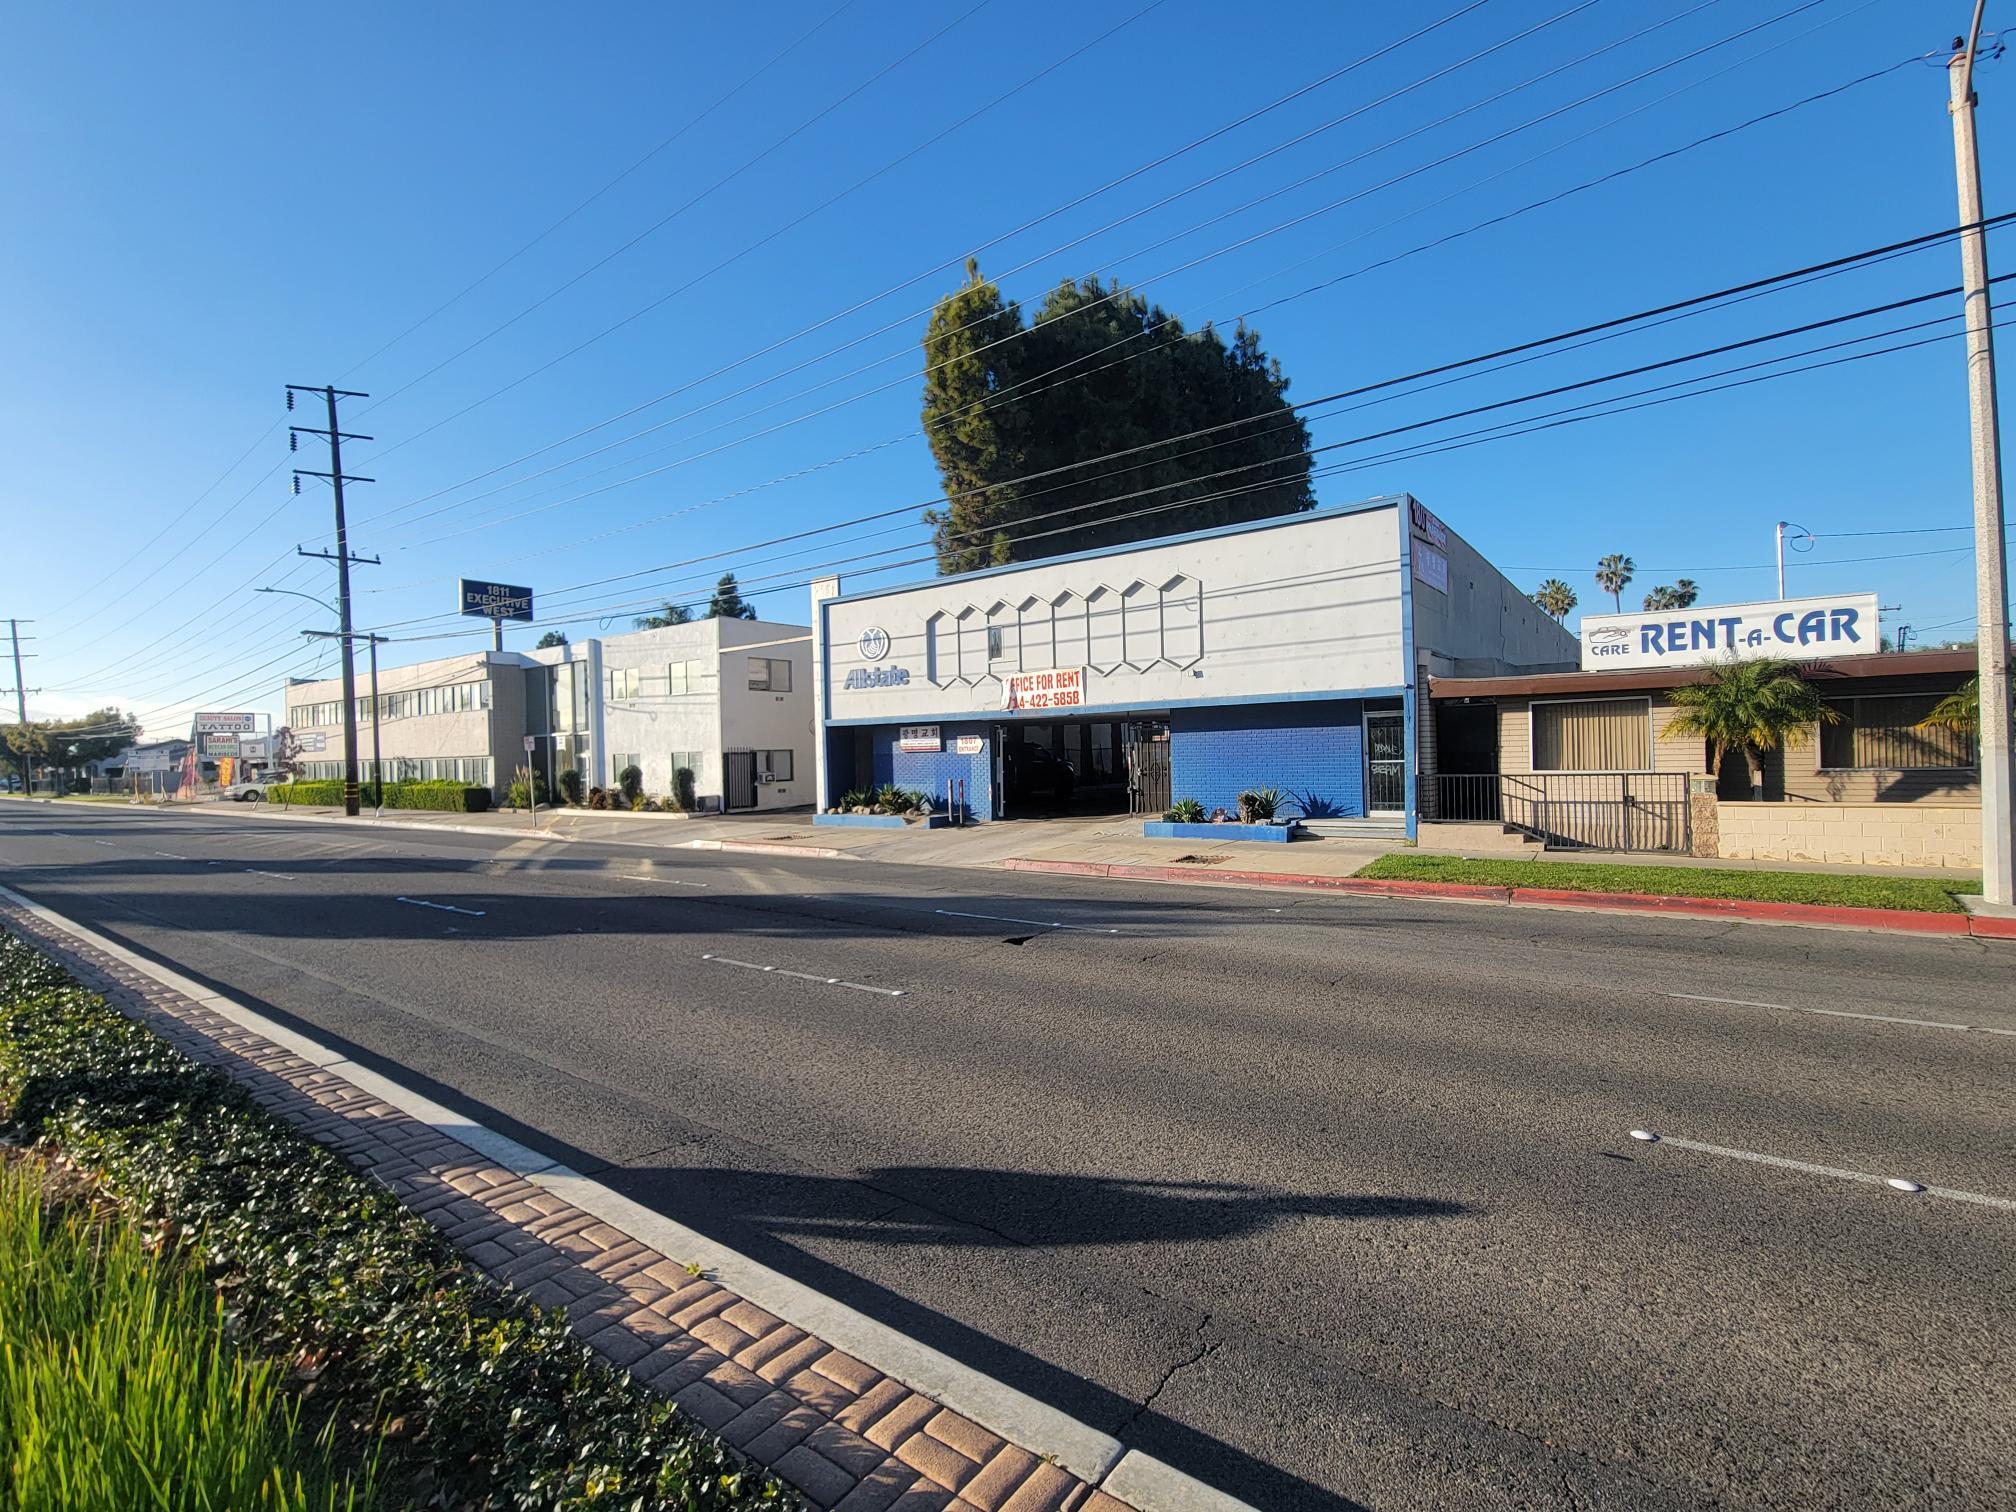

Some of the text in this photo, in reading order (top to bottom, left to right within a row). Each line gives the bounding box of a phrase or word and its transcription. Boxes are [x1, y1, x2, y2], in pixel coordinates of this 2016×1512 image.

[487, 585, 510, 597] 1811
[466, 592, 529, 609] EXECUTIVE
[482, 605, 515, 617] WEST
[1591, 643, 1630, 656] CARE
[843, 665, 910, 690] Allstate
[1036, 674, 1053, 691] FOR
[1056, 671, 1080, 688] RENT
